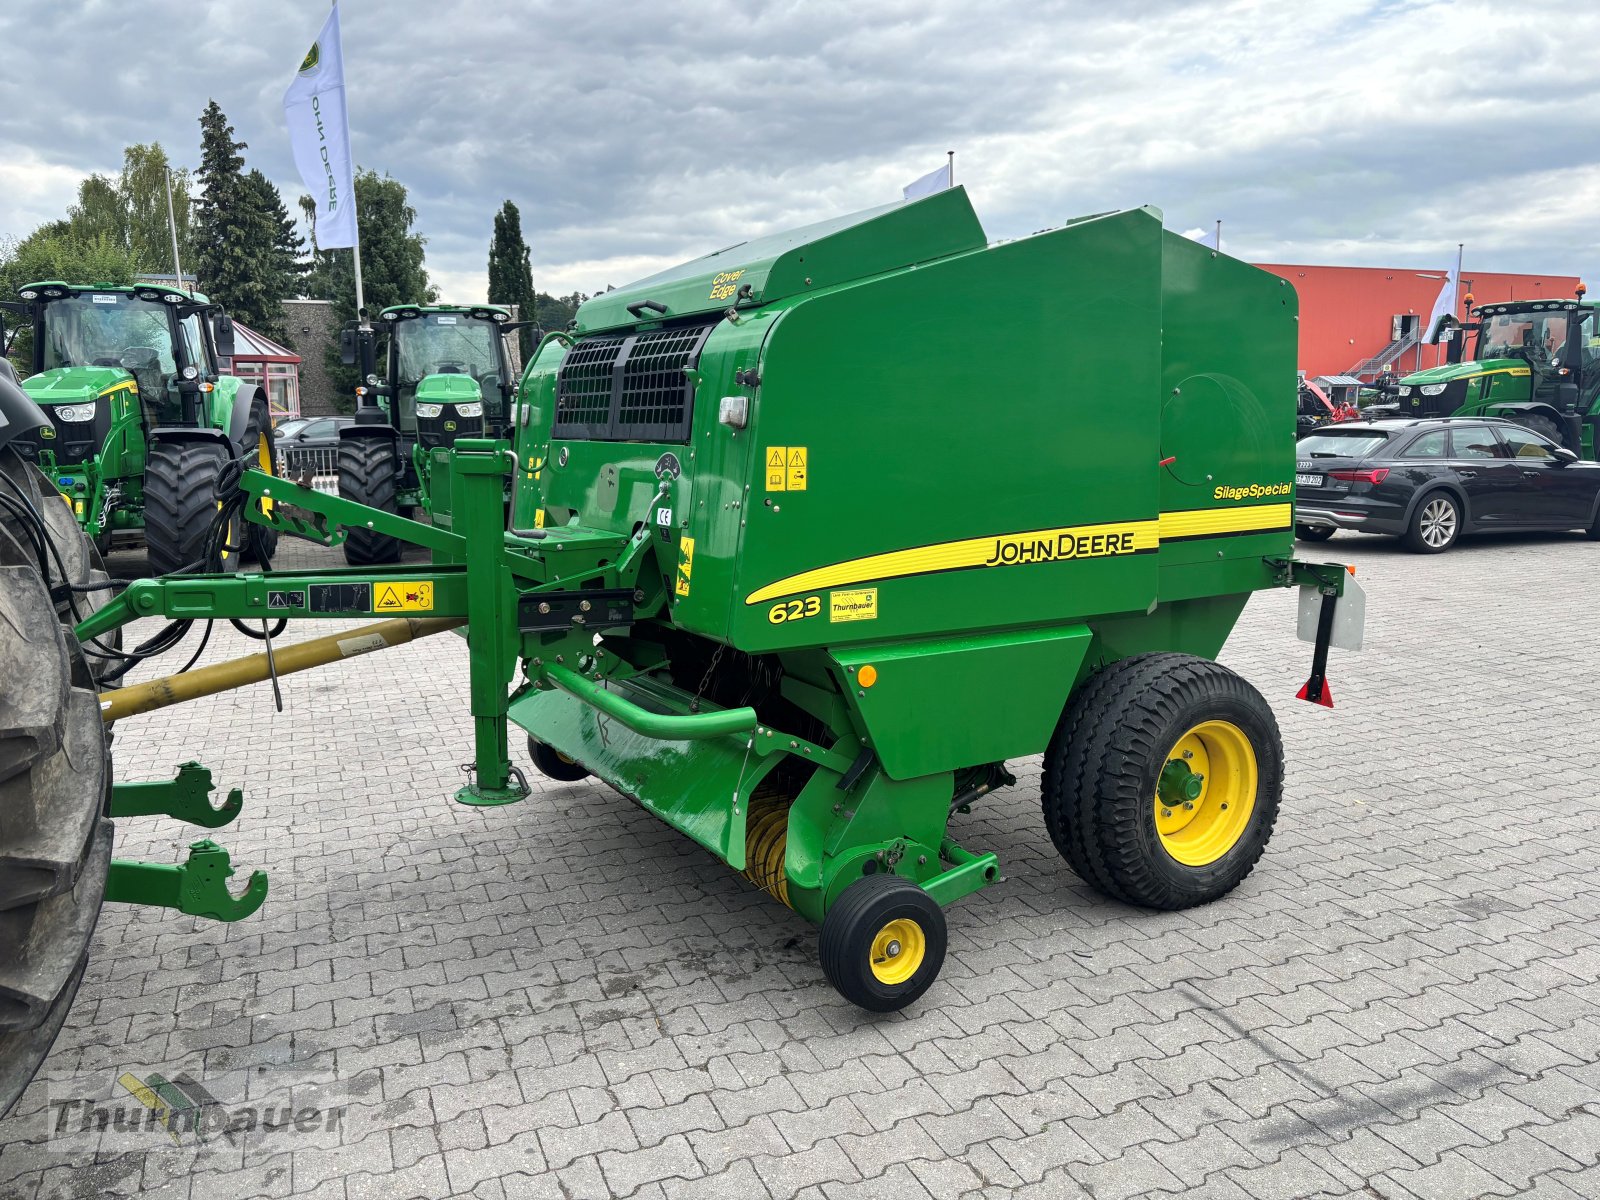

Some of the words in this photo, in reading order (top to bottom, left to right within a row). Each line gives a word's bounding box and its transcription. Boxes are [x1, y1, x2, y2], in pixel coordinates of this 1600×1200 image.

[712, 269, 746, 285] Cover
[709, 284, 737, 300] Edge
[1214, 482, 1292, 500] SilageSpecial
[986, 539, 1053, 564] JOHN
[1058, 533, 1135, 557] DEERE
[768, 595, 821, 624] 623
[833, 602, 874, 611] Thurnbauer
